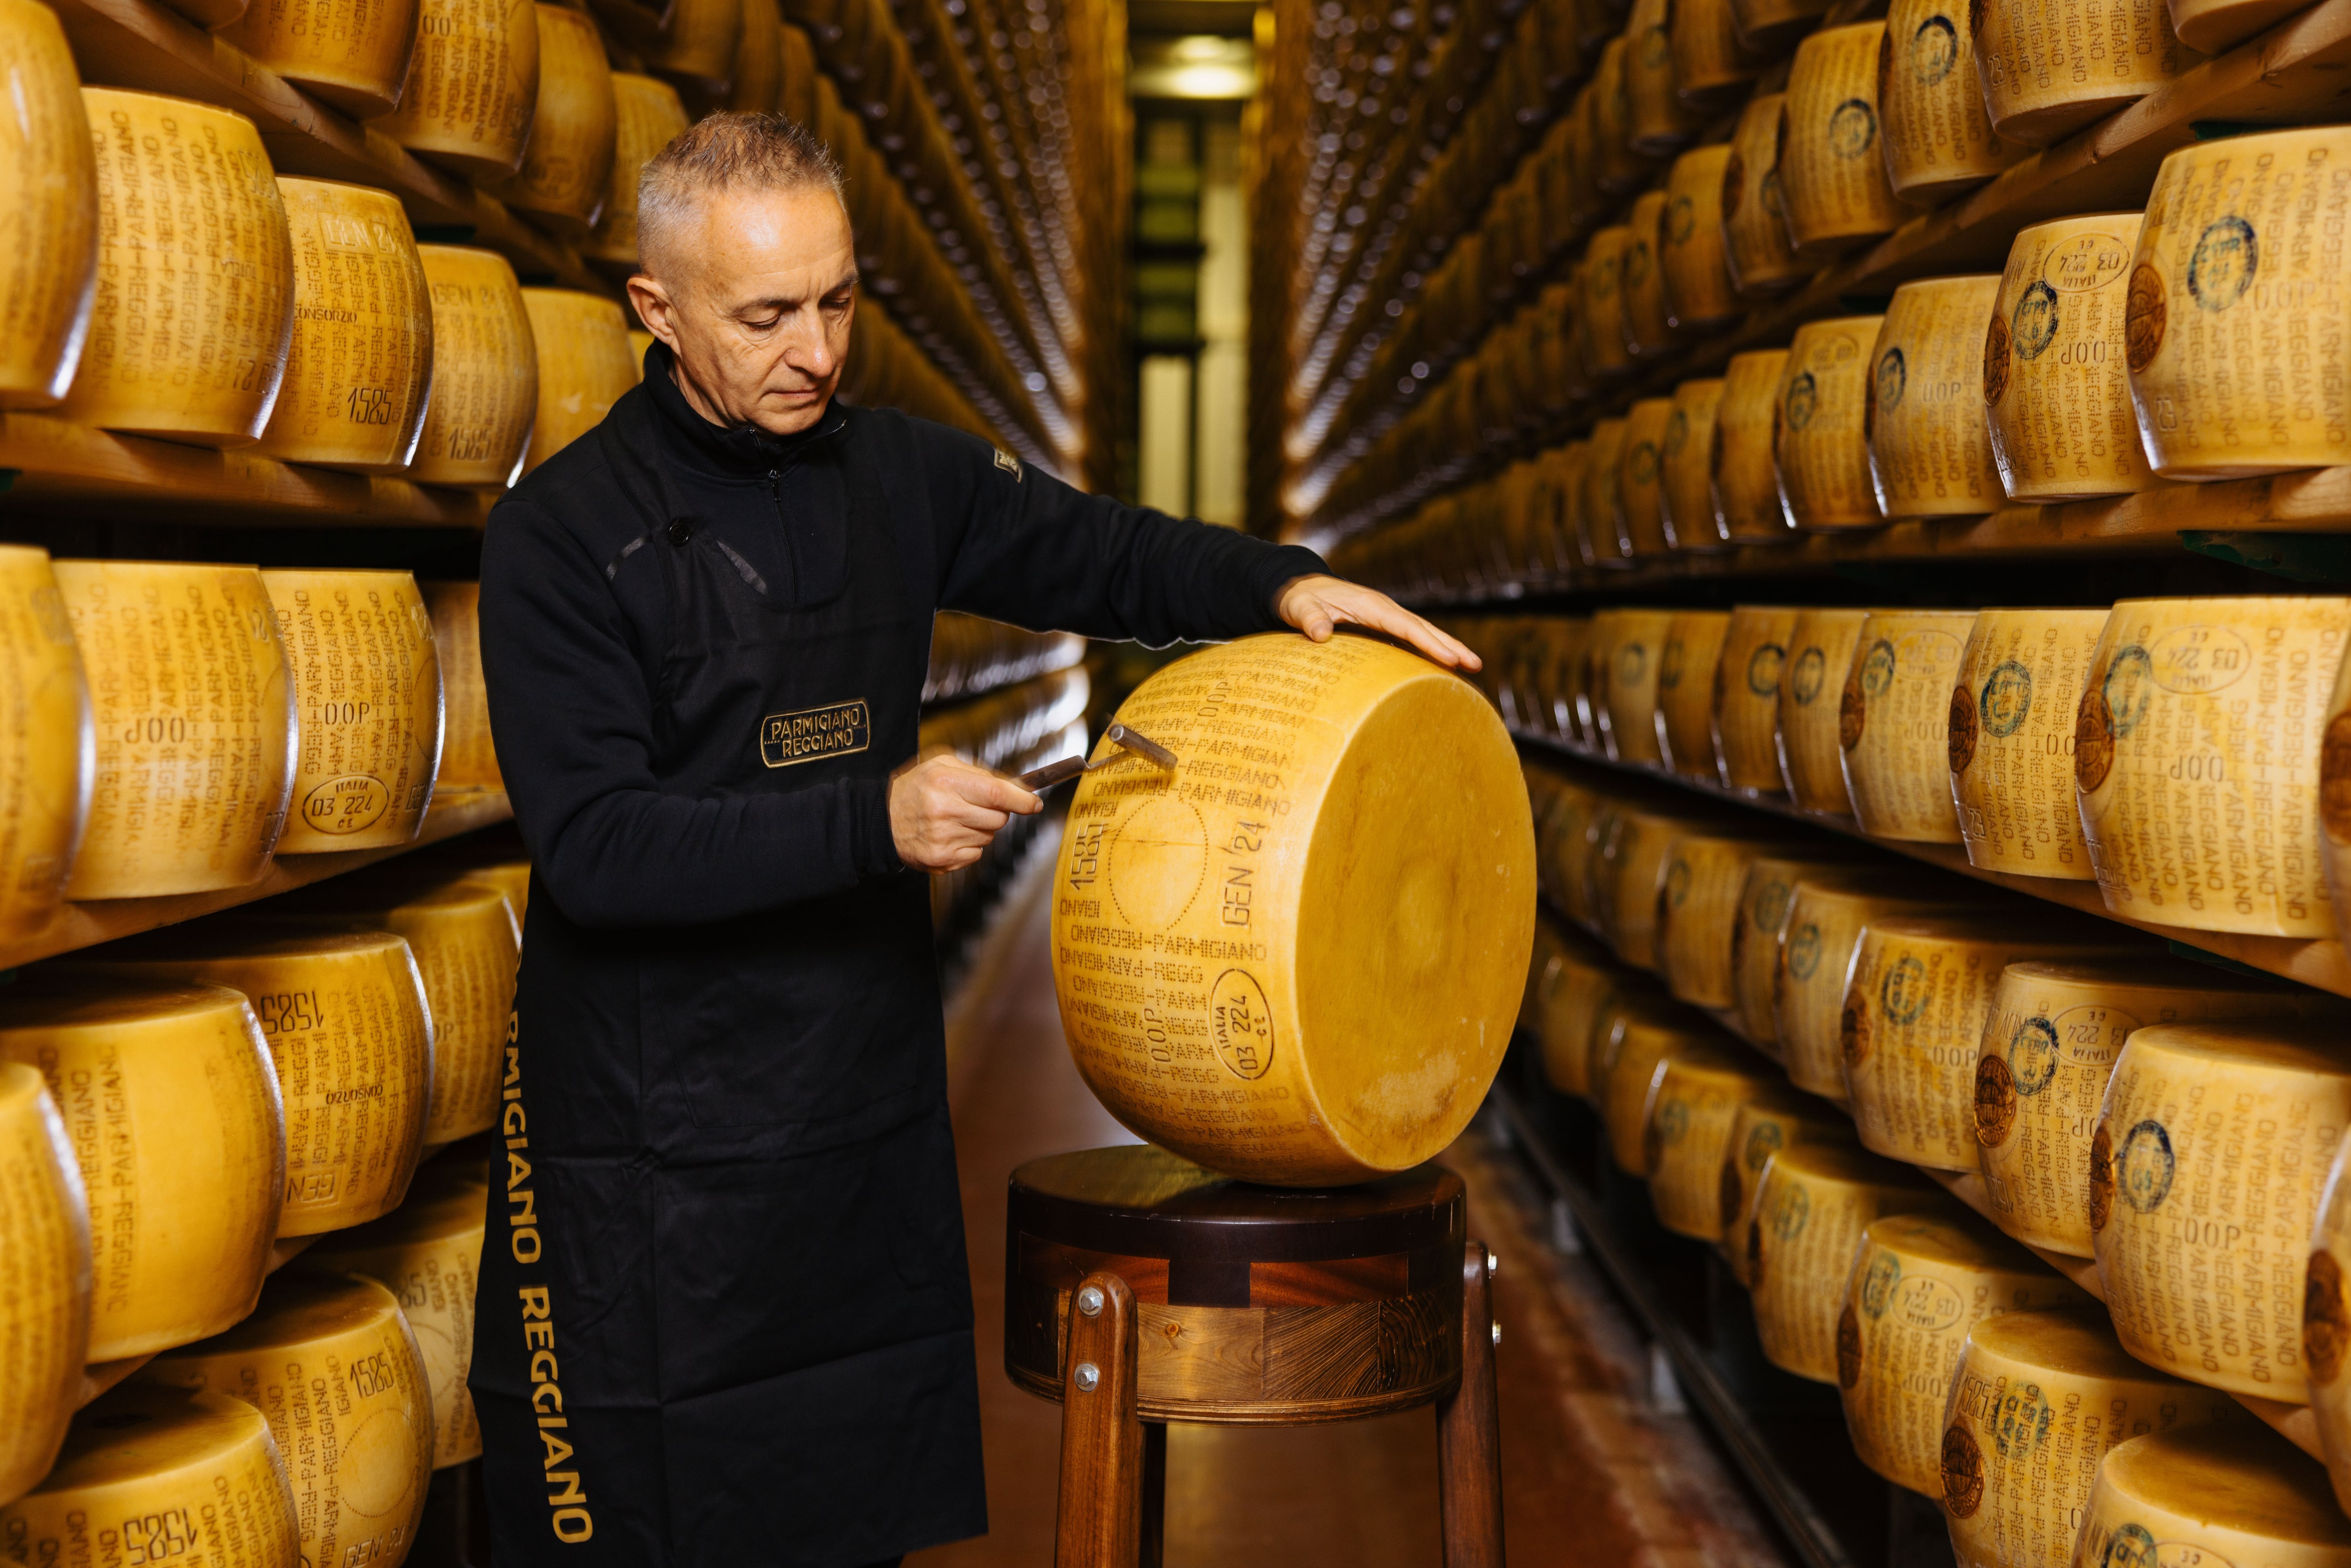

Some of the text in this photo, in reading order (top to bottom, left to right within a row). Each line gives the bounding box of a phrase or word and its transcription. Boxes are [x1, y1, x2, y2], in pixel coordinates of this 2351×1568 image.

[347, 386, 394, 425] 1585
[772, 708, 860, 741] PARMIGIANO
[782, 728, 854, 758] REGGIANO
[335, 780, 369, 794] ITALIA
[310, 798, 335, 817] 03
[337, 818, 354, 828] CE
[504, 945, 593, 1544] RMIGIANO REGGIANO
[2183, 1217, 2242, 1251] DOP
[350, 1352, 394, 1399] 1585
